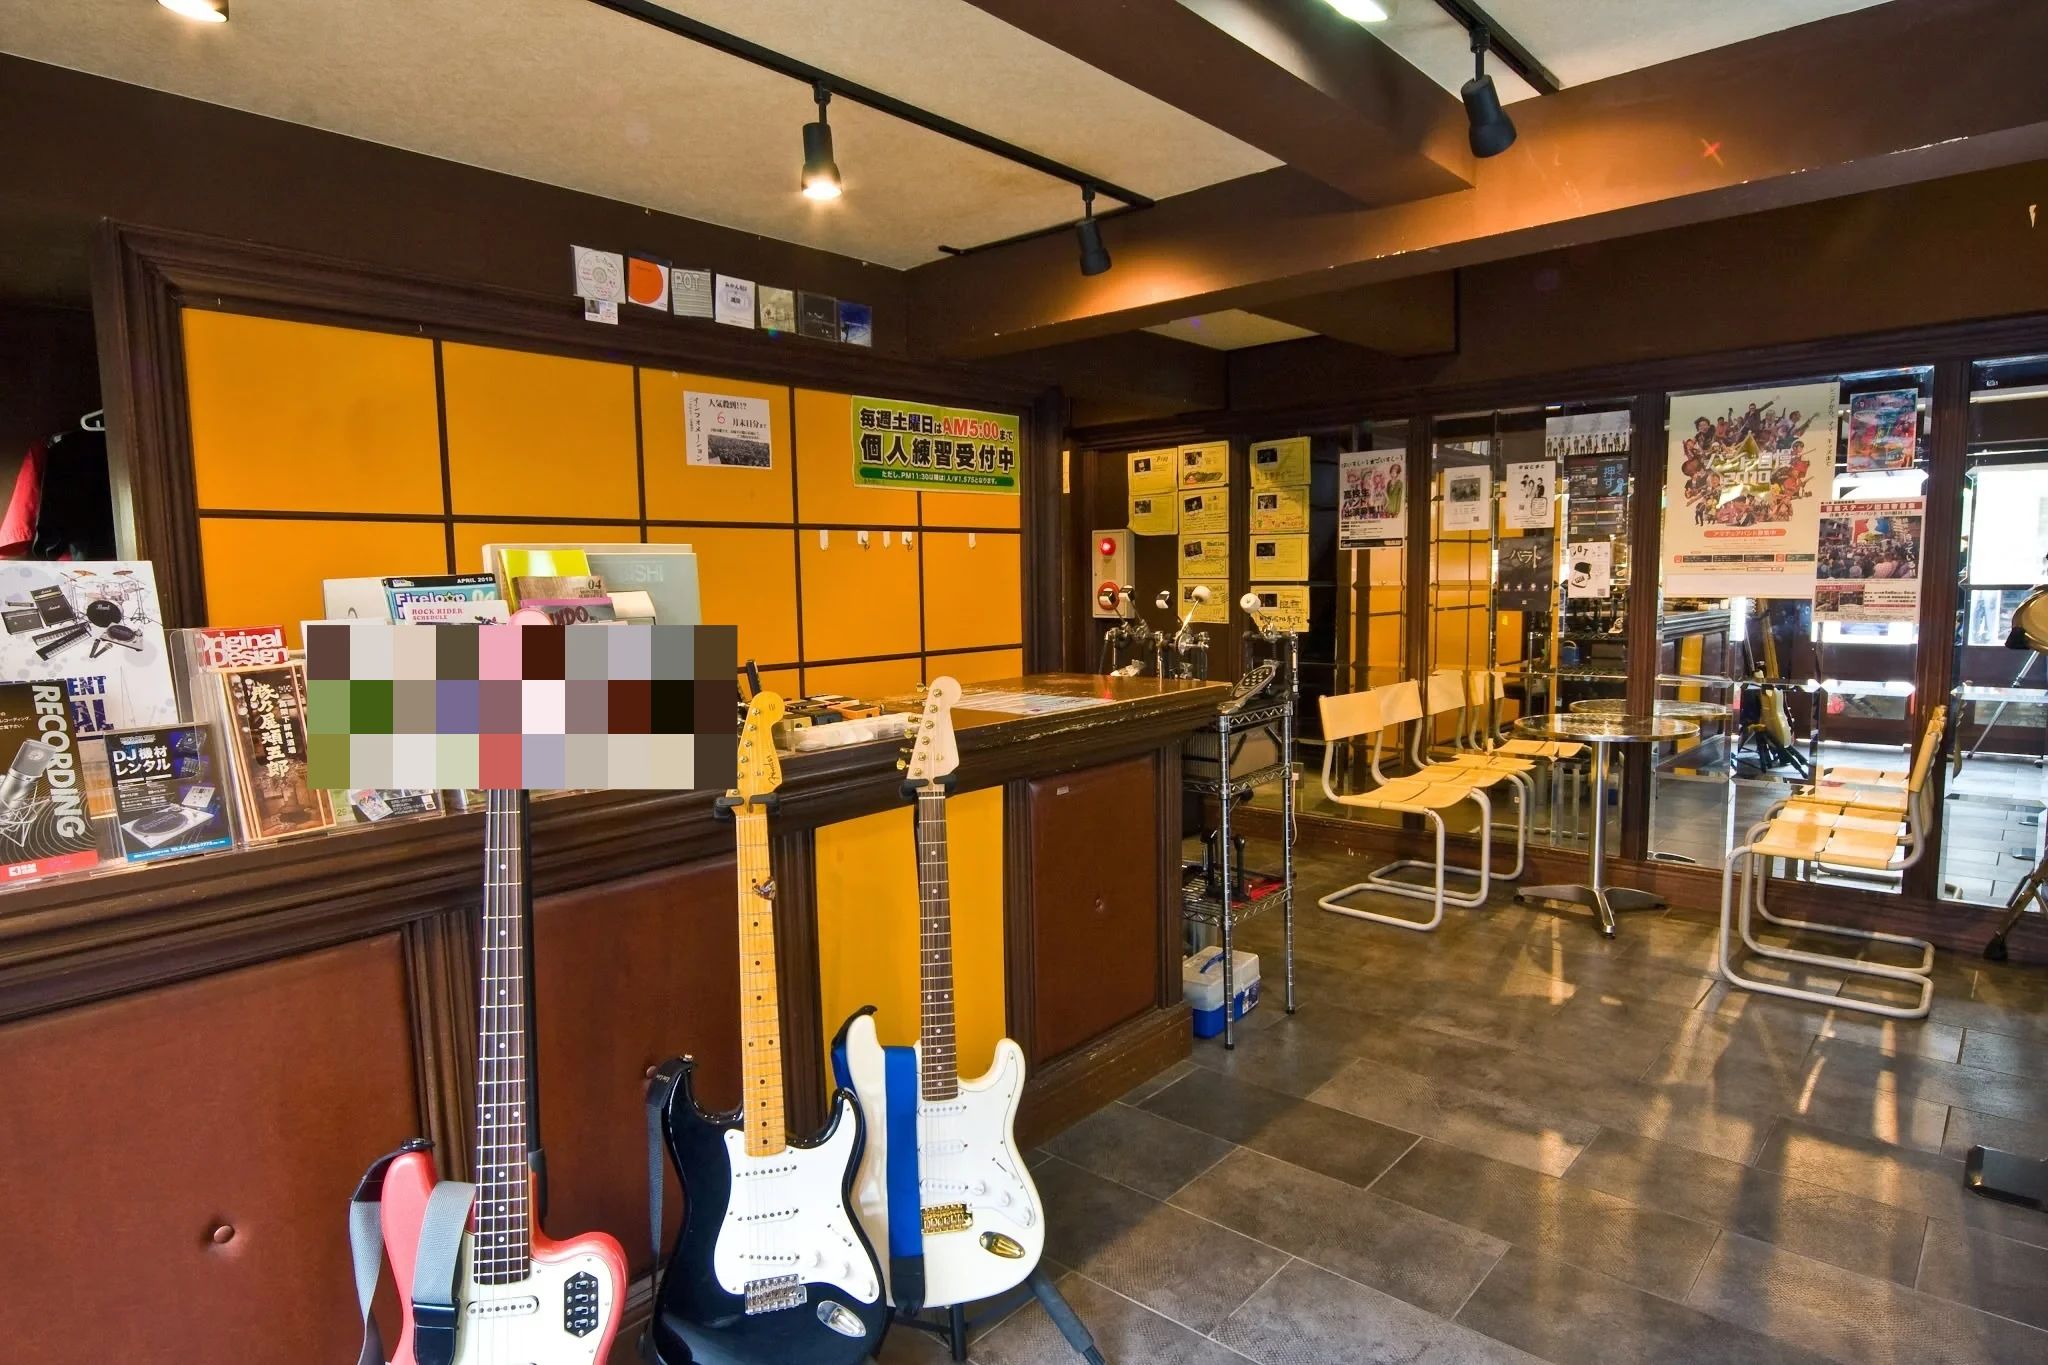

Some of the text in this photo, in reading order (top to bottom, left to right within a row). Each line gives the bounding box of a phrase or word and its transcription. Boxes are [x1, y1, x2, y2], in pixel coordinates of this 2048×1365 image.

[716, 411, 726, 425] 6
[859, 432, 1014, 473] 個人練習受付中
[1603, 465, 1617, 488] 押す
[588, 579, 601, 590] 04
[32, 685, 87, 838] RECORDING
[112, 745, 168, 763] DJ機材
[114, 758, 172, 776] レンタル
